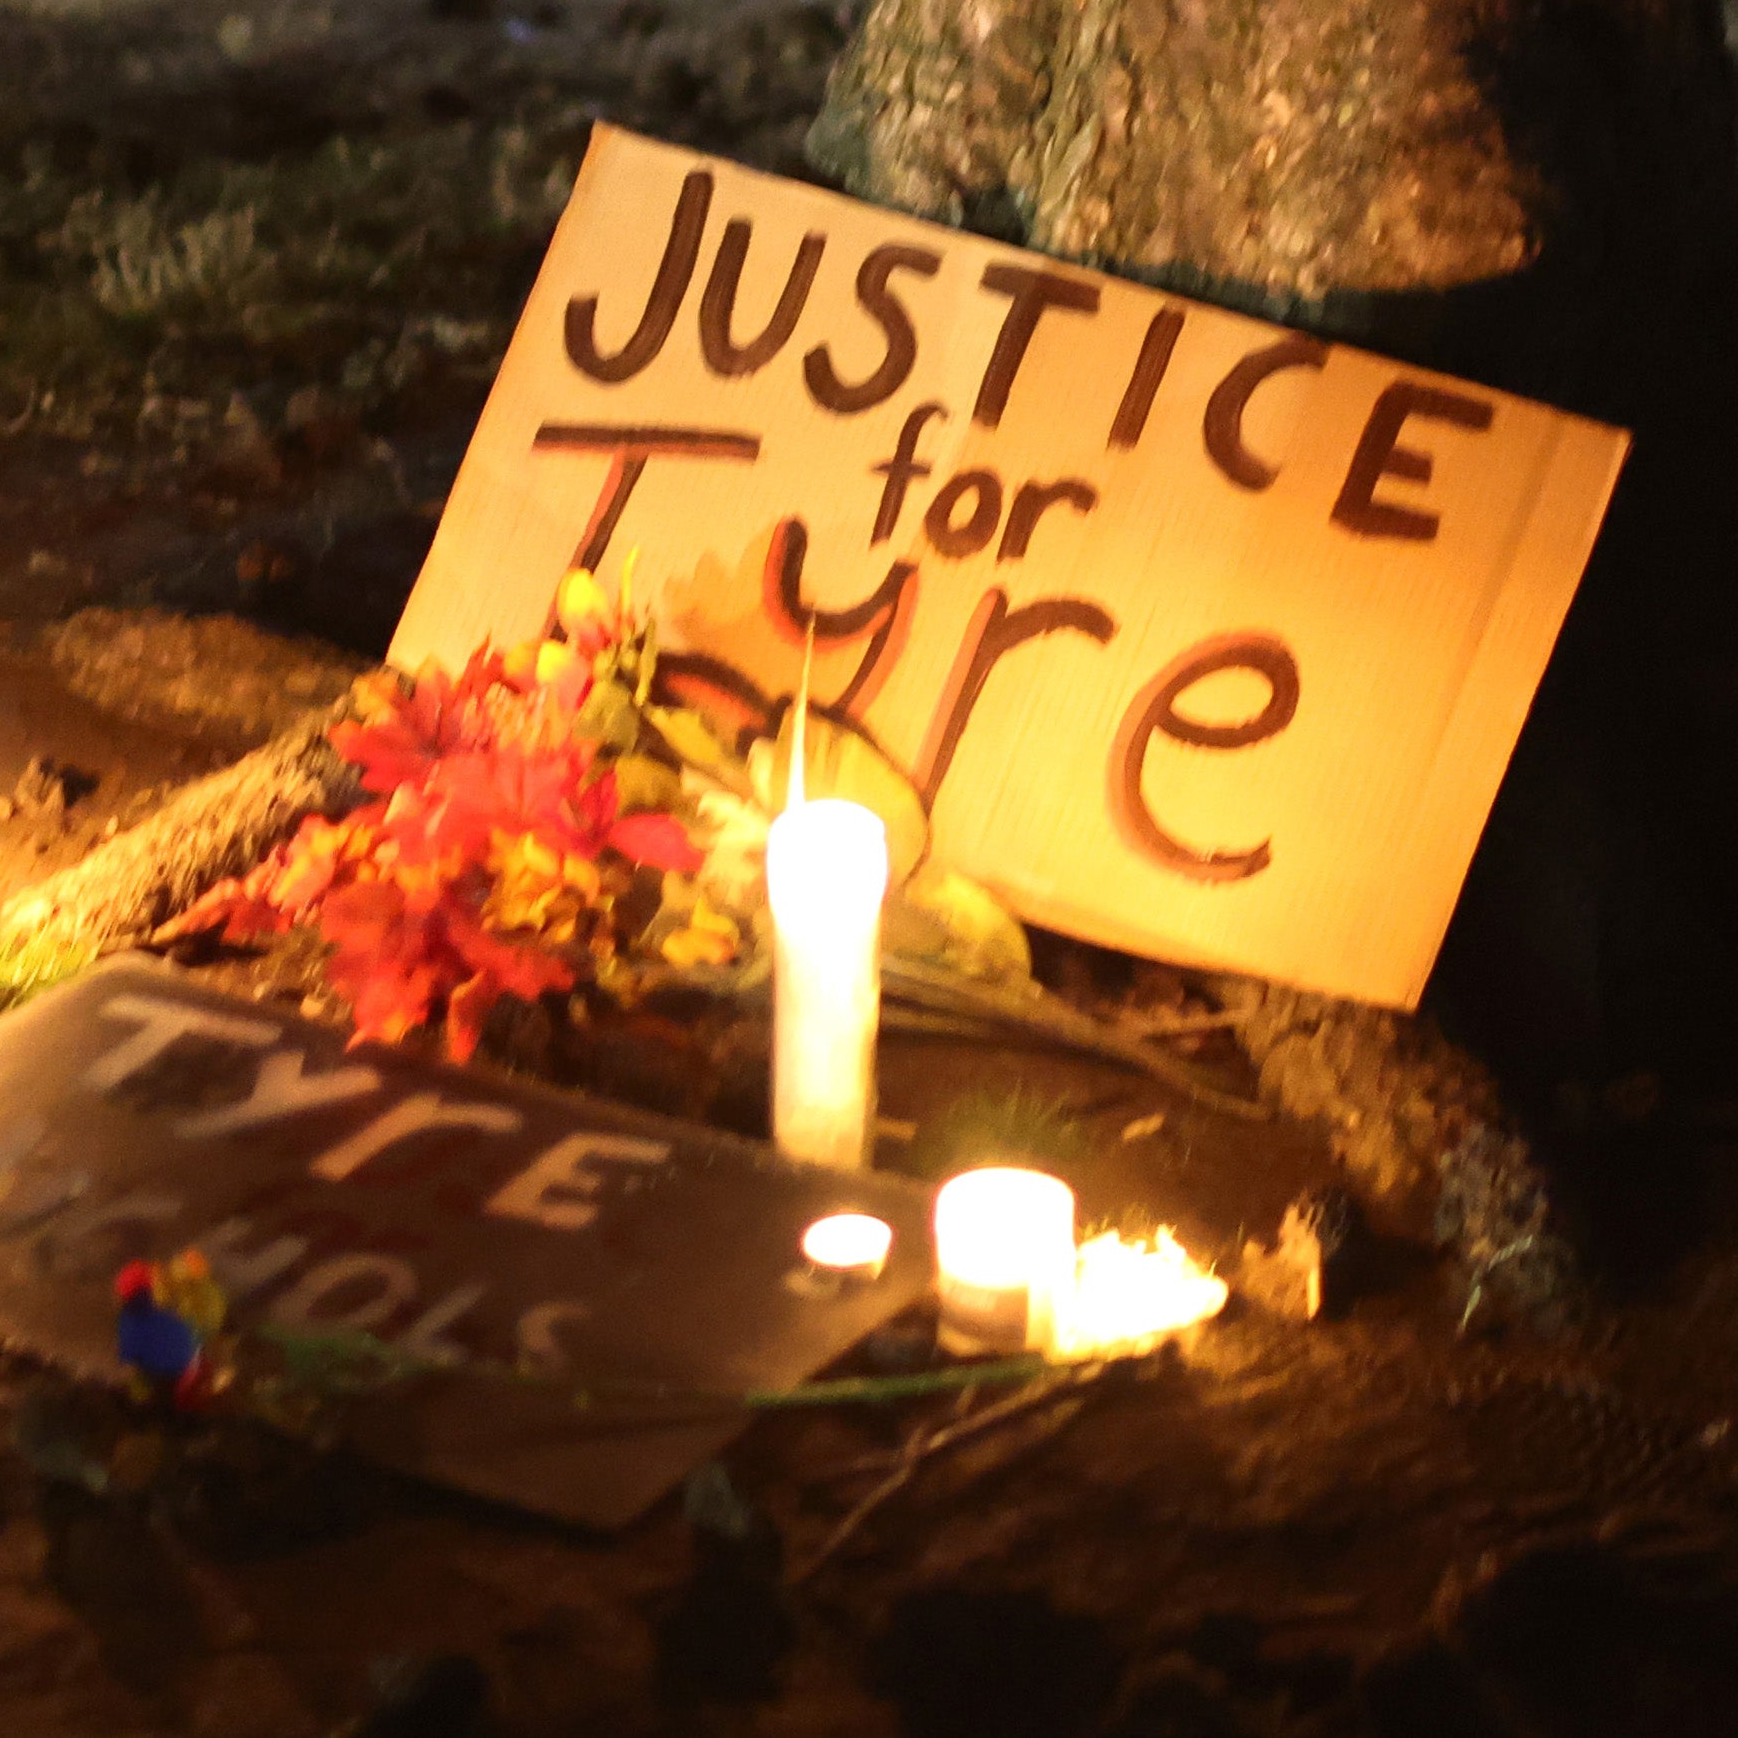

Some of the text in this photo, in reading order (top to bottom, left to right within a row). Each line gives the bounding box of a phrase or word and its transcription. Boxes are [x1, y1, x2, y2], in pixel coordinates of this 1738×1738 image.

[563, 170, 1497, 541] JUSTICE
[871, 401, 1098, 564] for
[531, 425, 1302, 884] Tyre
